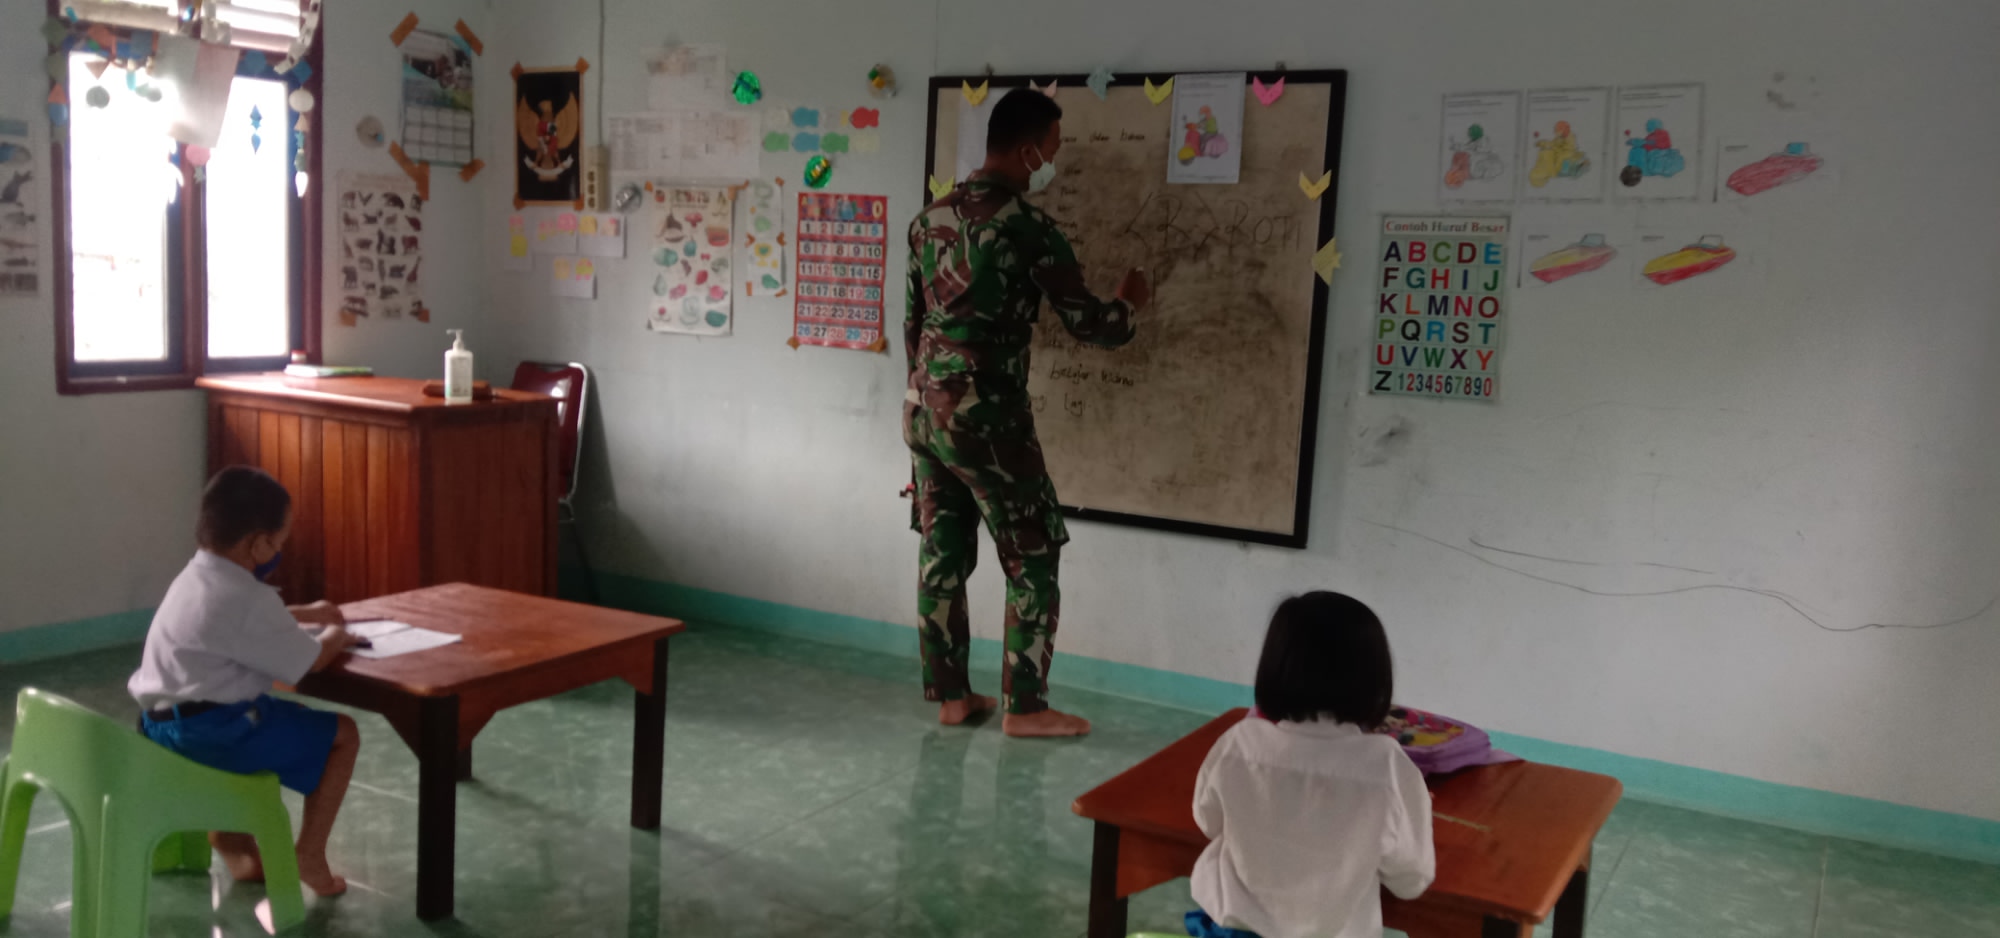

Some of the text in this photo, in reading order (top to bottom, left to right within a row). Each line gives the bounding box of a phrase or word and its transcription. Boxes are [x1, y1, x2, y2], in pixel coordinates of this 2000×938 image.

[806, 223, 878, 235] 1 2 3 4 5
[1386, 221, 1428, 232] Contoh
[1472, 222, 1504, 233] Besar
[804, 243, 880, 257] 6 7 8 9 10
[1384, 241, 1501, 264] A B C D E
[801, 264, 879, 278] 11 12 13 14 15
[1383, 267, 1498, 291] F G H I J
[801, 285, 879, 299] 16 17 18 19 20
[799, 305, 877, 320] 21 22 23 24 25
[1380, 294, 1498, 318] K L M N O
[799, 326, 876, 341] 26 27 28 29 30
[1379, 319, 1495, 344] P Q R S T
[1377, 345, 1494, 370] U V W X Y
[1375, 371, 1392, 391] Z
